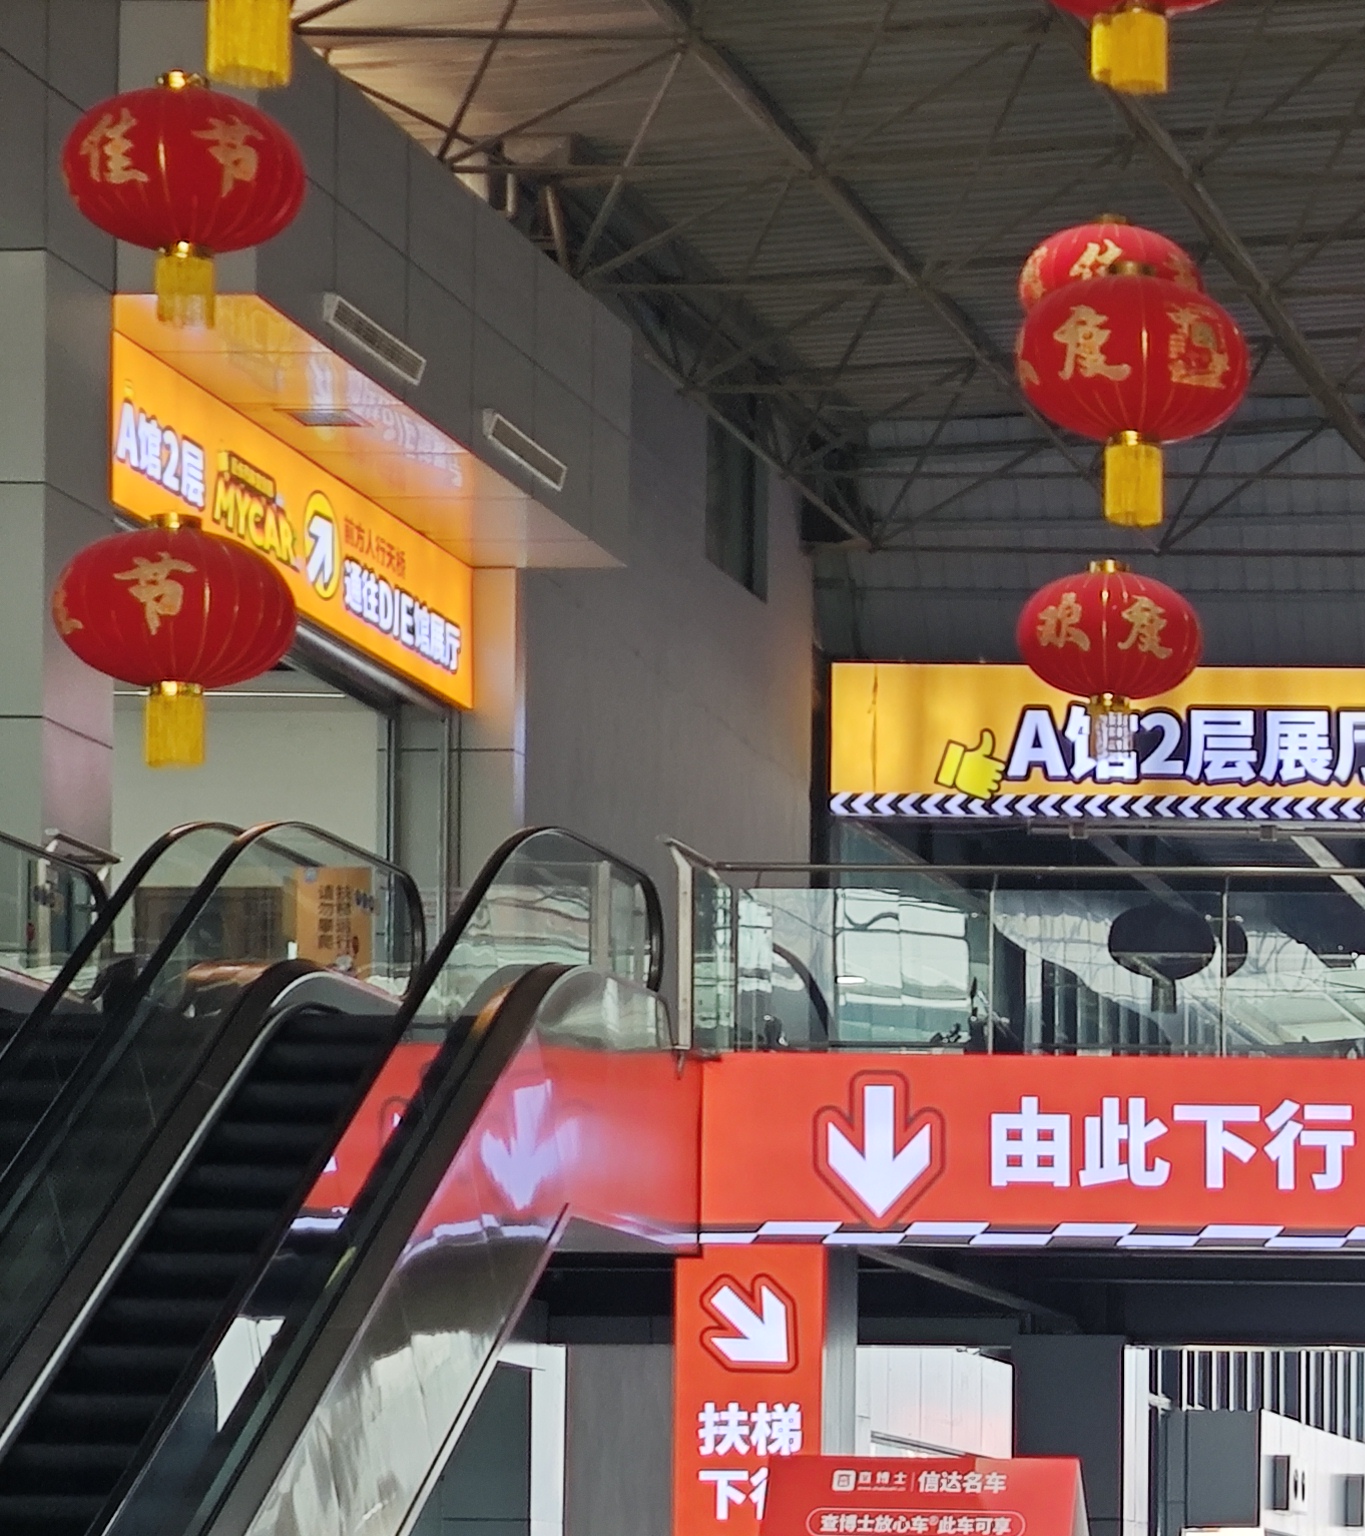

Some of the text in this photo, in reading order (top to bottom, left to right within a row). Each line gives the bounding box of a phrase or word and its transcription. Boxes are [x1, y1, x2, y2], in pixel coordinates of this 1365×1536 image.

[115, 400, 206, 511] A馆2层
[213, 472, 300, 573] MYCAR
[989, 1096, 1355, 1190] 由此下行
[698, 1403, 803, 1457] 扶梯
[917, 1470, 1008, 1494] 信达名车
